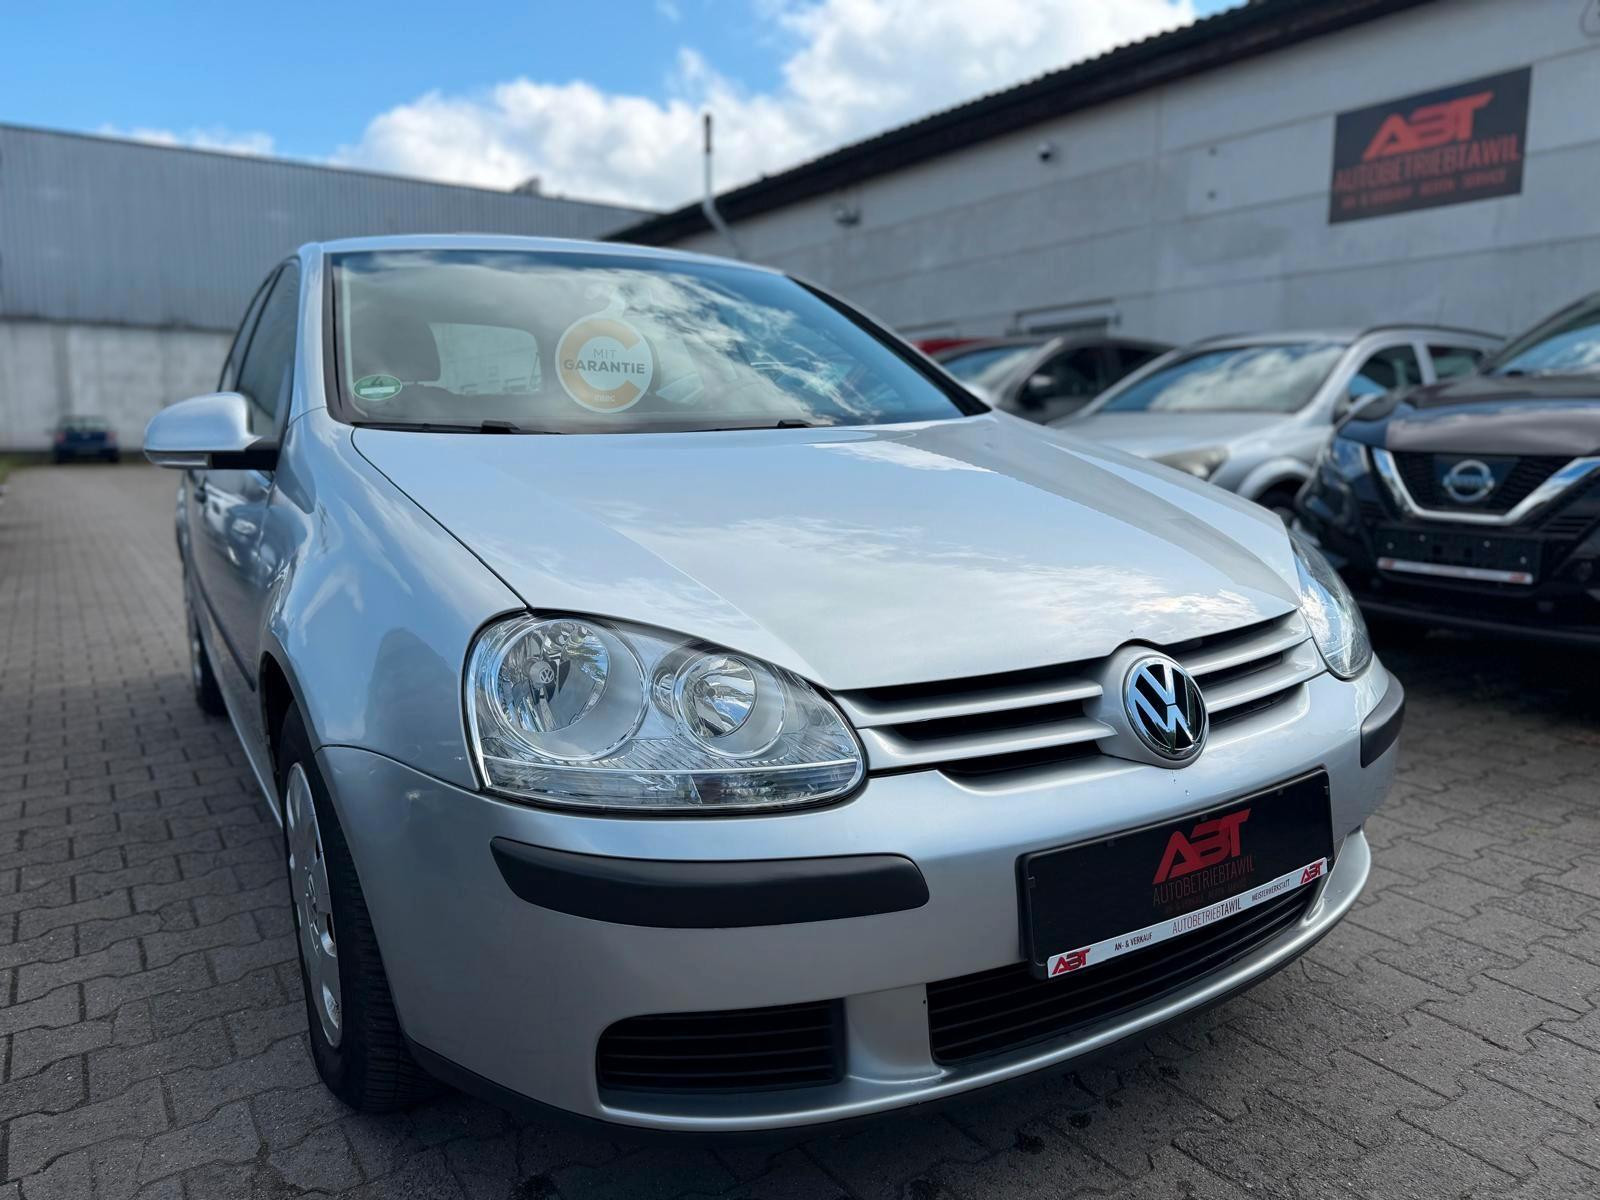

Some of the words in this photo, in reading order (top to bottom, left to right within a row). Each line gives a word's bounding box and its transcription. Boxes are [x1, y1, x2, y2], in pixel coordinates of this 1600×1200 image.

[1363, 90, 1494, 160] ABT
[563, 359, 645, 375] GARANTIE
[593, 349, 617, 359] MIT
[1152, 808, 1251, 884] ABT
[1152, 856, 1255, 906] AUTOBETRIEBTAWIL
[1051, 948, 1091, 976] ABT
[1130, 932, 1152, 946] VERKAUF
[1172, 898, 1242, 934] AUTOBETRIEBTAWIL
[1251, 878, 1291, 902] MEISTERWERKSTATT
[1300, 860, 1324, 884] ABT
